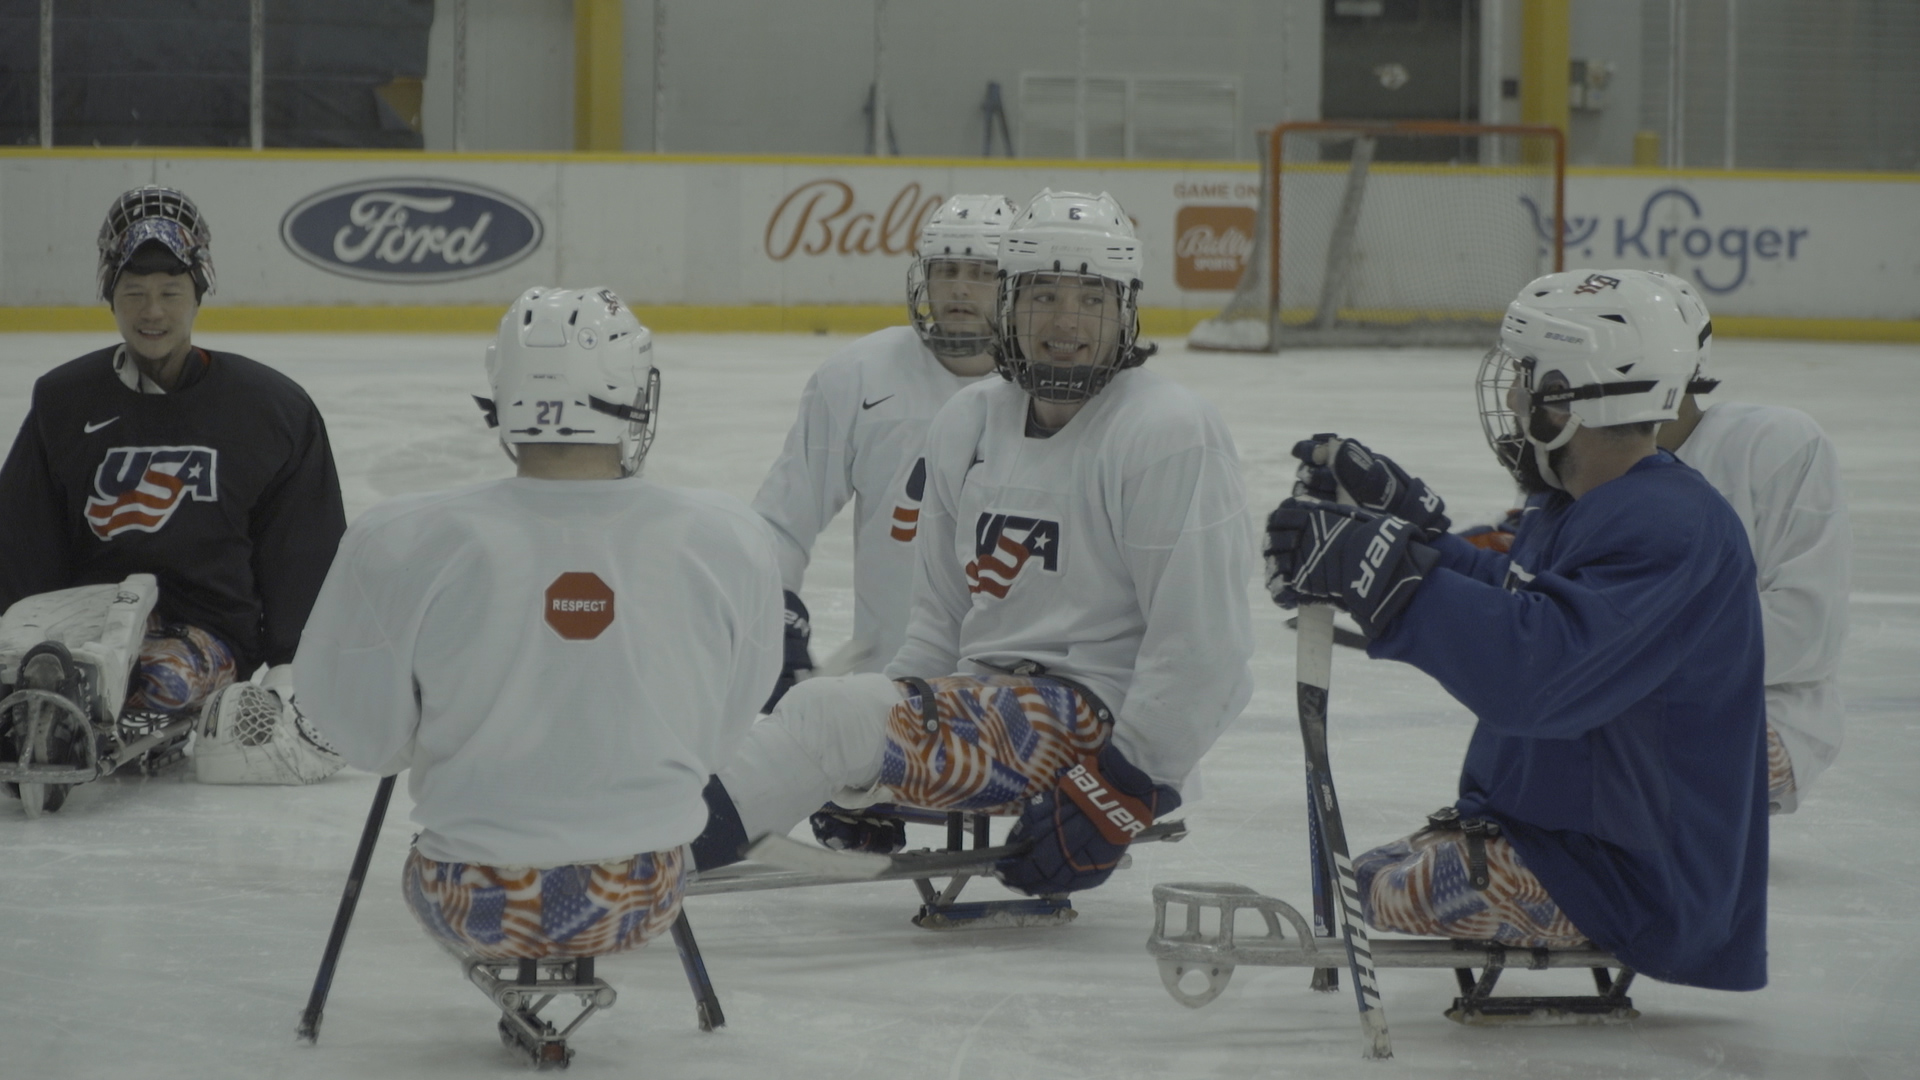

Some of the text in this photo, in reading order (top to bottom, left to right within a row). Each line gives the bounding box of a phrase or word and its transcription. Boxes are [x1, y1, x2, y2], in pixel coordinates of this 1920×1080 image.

[333, 191, 492, 263] Ford
[763, 177, 942, 262] Ball
[957, 208, 969, 219] 4
[1173, 184, 1229, 198] GAME
[1613, 185, 1810, 295] Kroger
[1544, 331, 1585, 345] BAUER
[535, 400, 565, 425] 27
[85, 445, 219, 541] USA
[965, 510, 1060, 600] USA
[552, 600, 606, 612] RESPECT
[1066, 763, 1146, 838] BAUER
